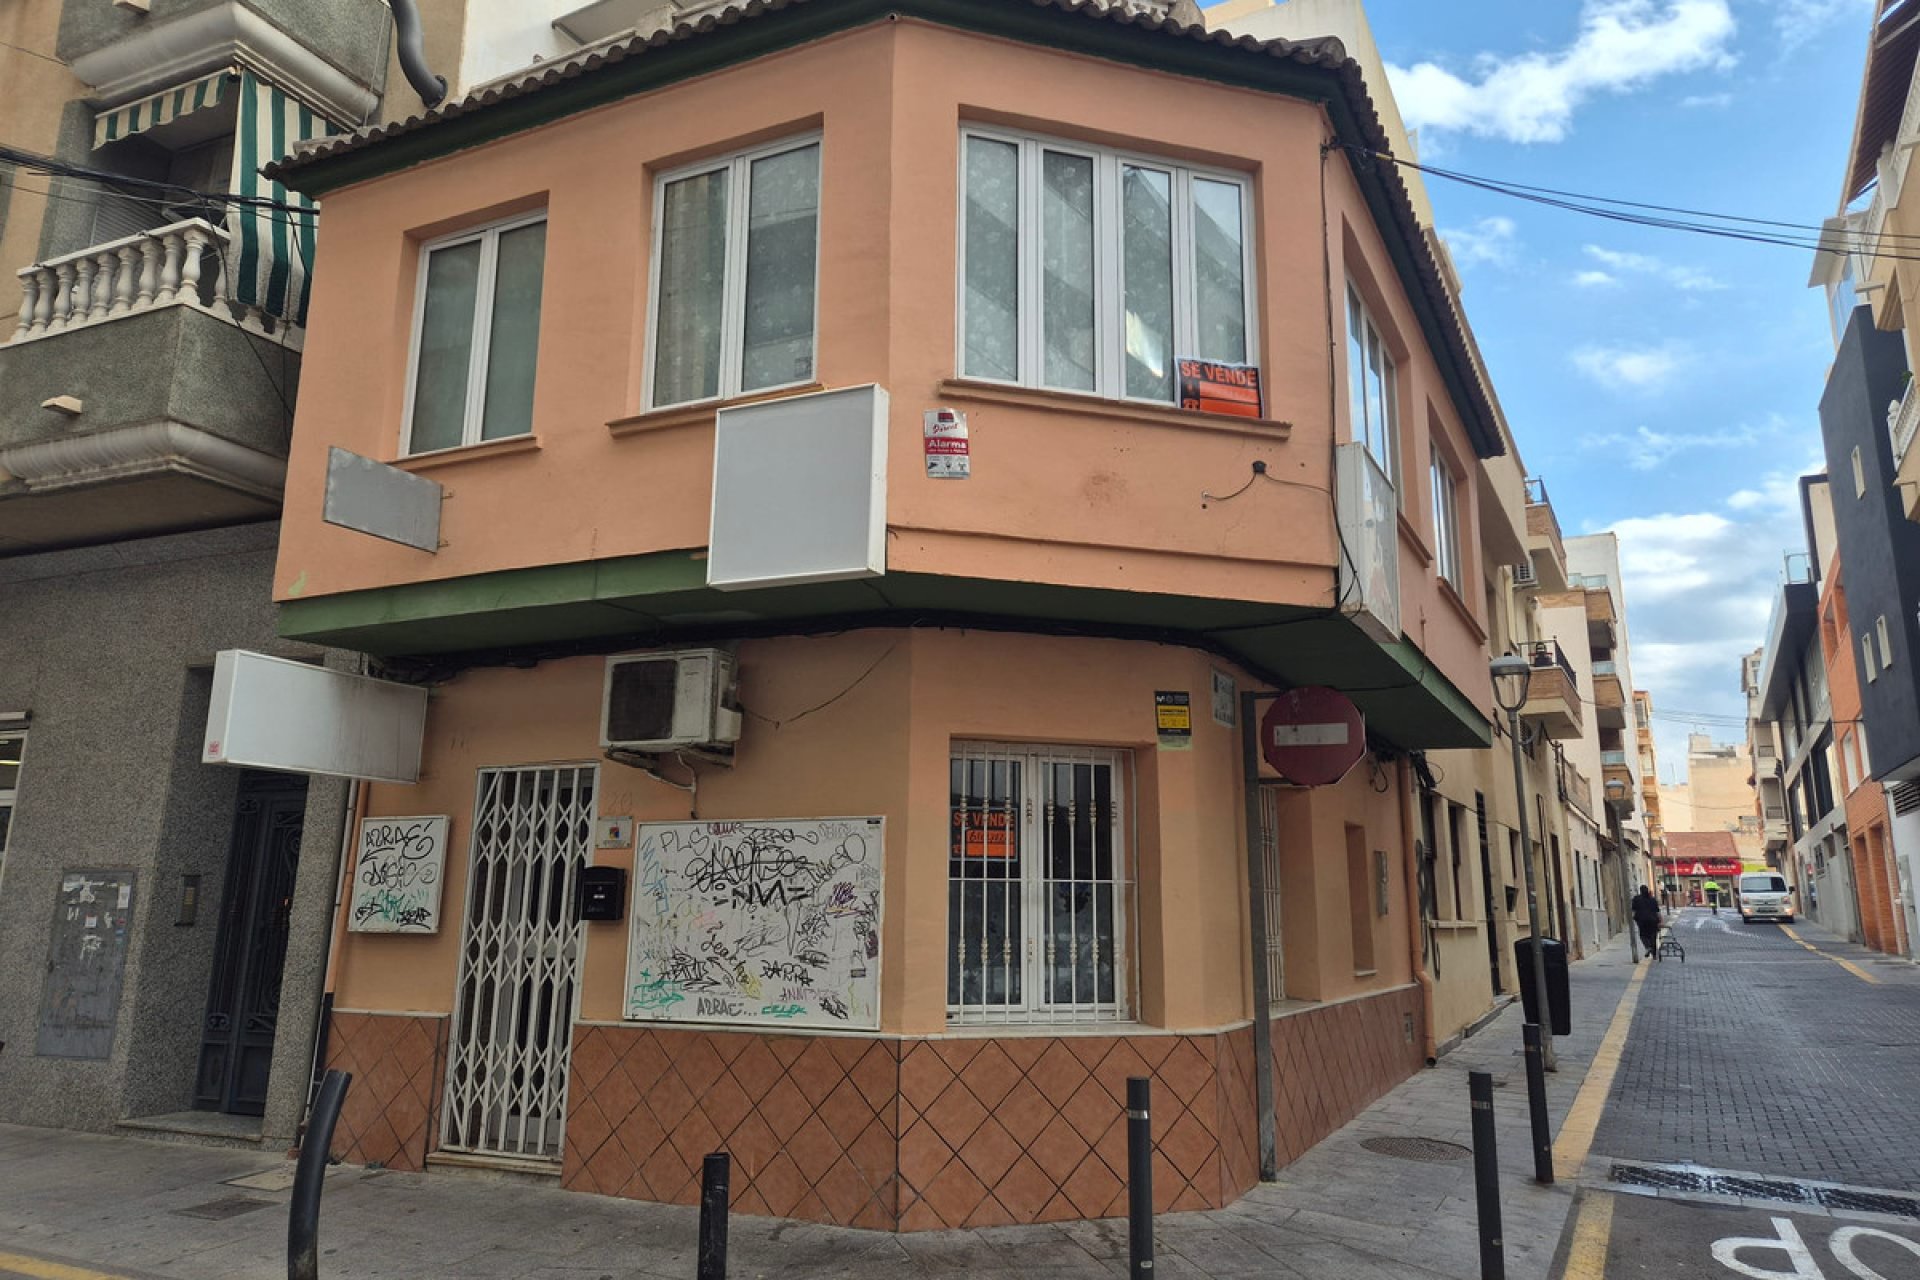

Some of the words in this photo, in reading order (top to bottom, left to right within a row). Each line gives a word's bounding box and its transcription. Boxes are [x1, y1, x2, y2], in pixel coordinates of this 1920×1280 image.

[1181, 360, 1201, 379] SE
[1204, 365, 1257, 386] VENDE
[928, 439, 967, 449] Alarma
[972, 811, 1014, 827] VNDE
